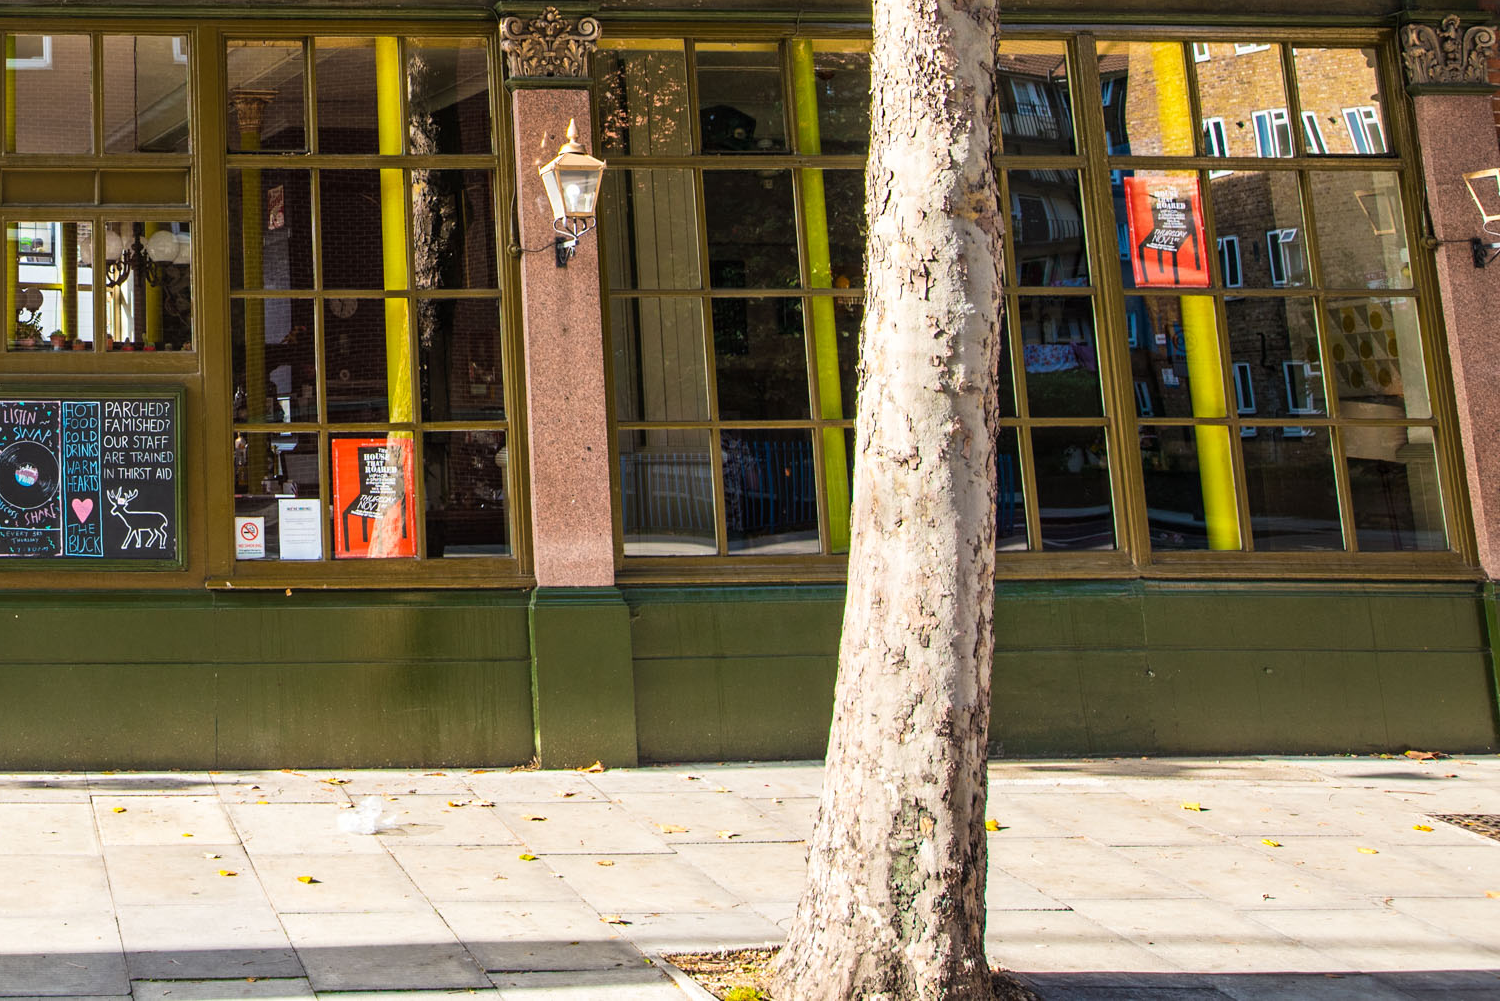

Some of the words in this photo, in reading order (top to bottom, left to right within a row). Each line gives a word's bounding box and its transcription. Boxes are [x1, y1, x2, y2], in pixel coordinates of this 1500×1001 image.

[1152, 235, 1170, 244] NOV
[1154, 229, 1188, 238] THURSDAY
[3, 408, 37, 425] LISTEN
[64, 403, 97, 418] HOT
[104, 401, 170, 418] PARCHED?
[65, 417, 98, 430] FOOD
[104, 418, 171, 433] FAMISHED?
[12, 426, 52, 443] SWAP
[65, 430, 98, 444] COLD
[103, 435, 129, 448] OUR
[132, 435, 170, 449] STAFF
[66, 442, 99, 458] DRINKS
[363, 453, 391, 461] HOUSE
[103, 451, 126, 464] ARE
[129, 451, 174, 463] TRAINED
[66, 460, 98, 475] WARM
[103, 468, 115, 479] IN
[117, 467, 152, 479] THIRST
[155, 467, 173, 480] AID
[67, 475, 99, 492] HEARTS
[357, 501, 377, 511] NOV
[360, 494, 397, 504] THURSDAY
[24, 502, 57, 526] SHARE
[68, 523, 96, 535] THE
[68, 534, 101, 553] BUCK
